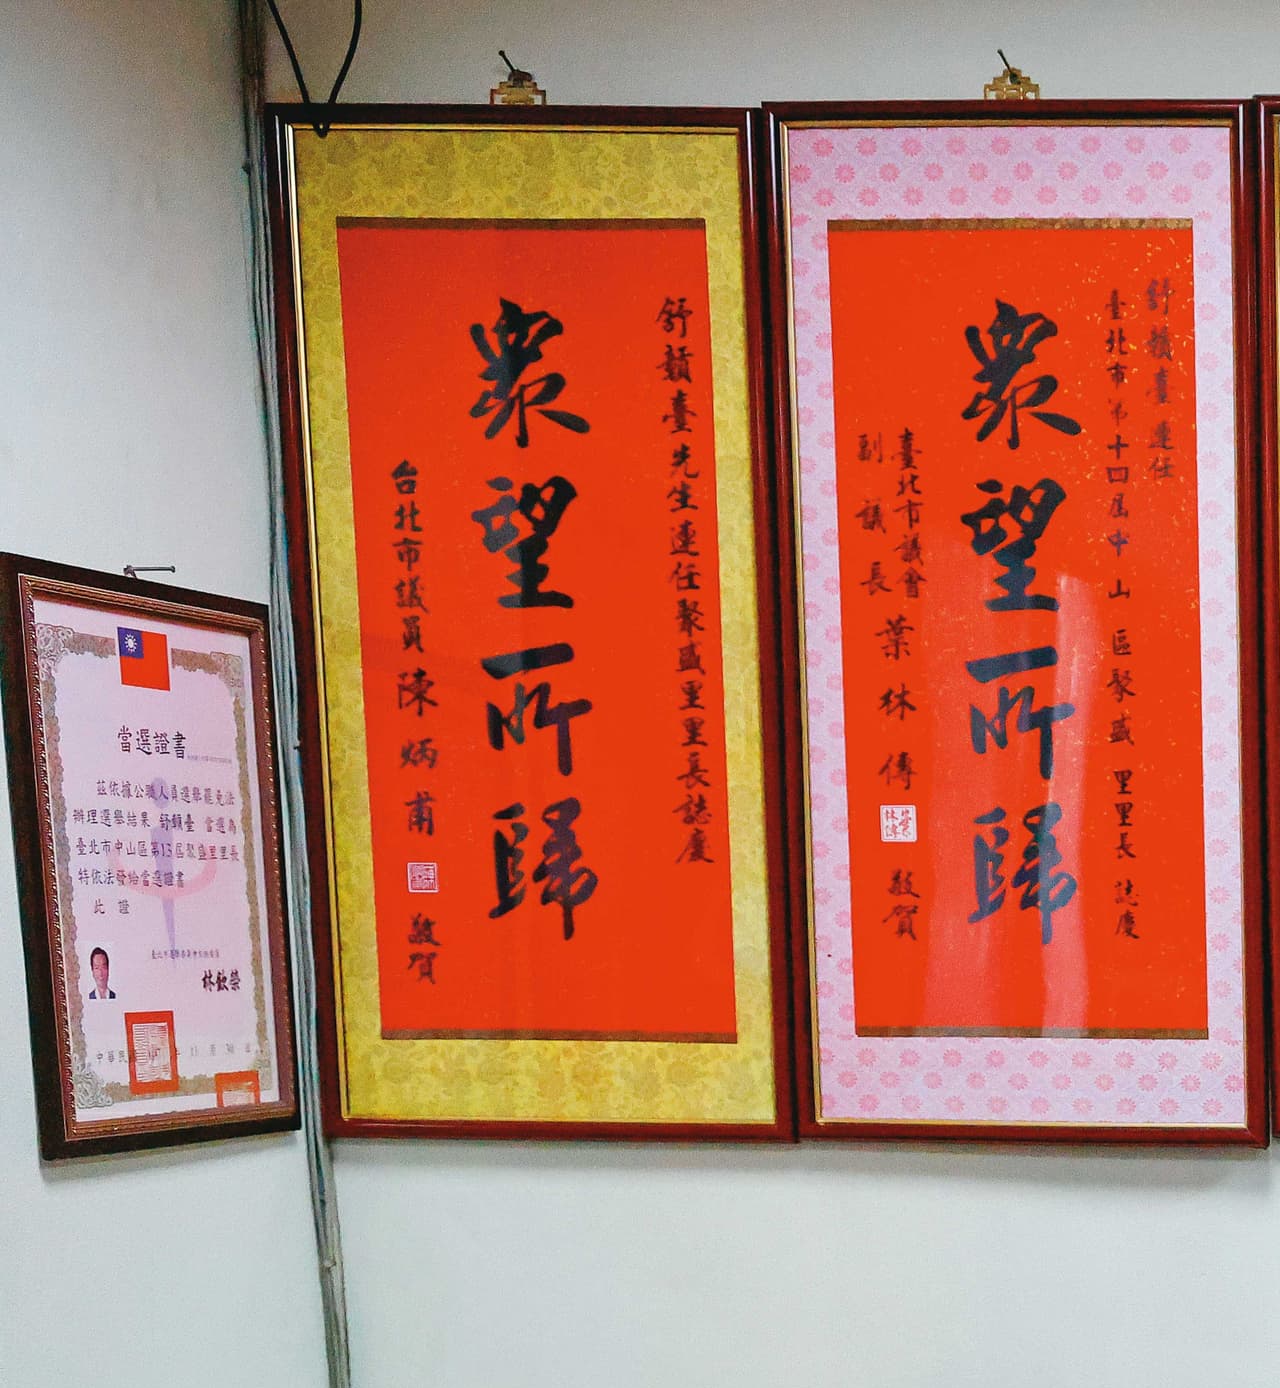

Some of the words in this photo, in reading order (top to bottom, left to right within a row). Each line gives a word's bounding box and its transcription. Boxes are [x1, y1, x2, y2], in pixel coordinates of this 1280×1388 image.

[117, 724, 187, 760] 當選證書
[883, 870, 922, 940] 敬賀
[408, 913, 442, 984] 敬賀
